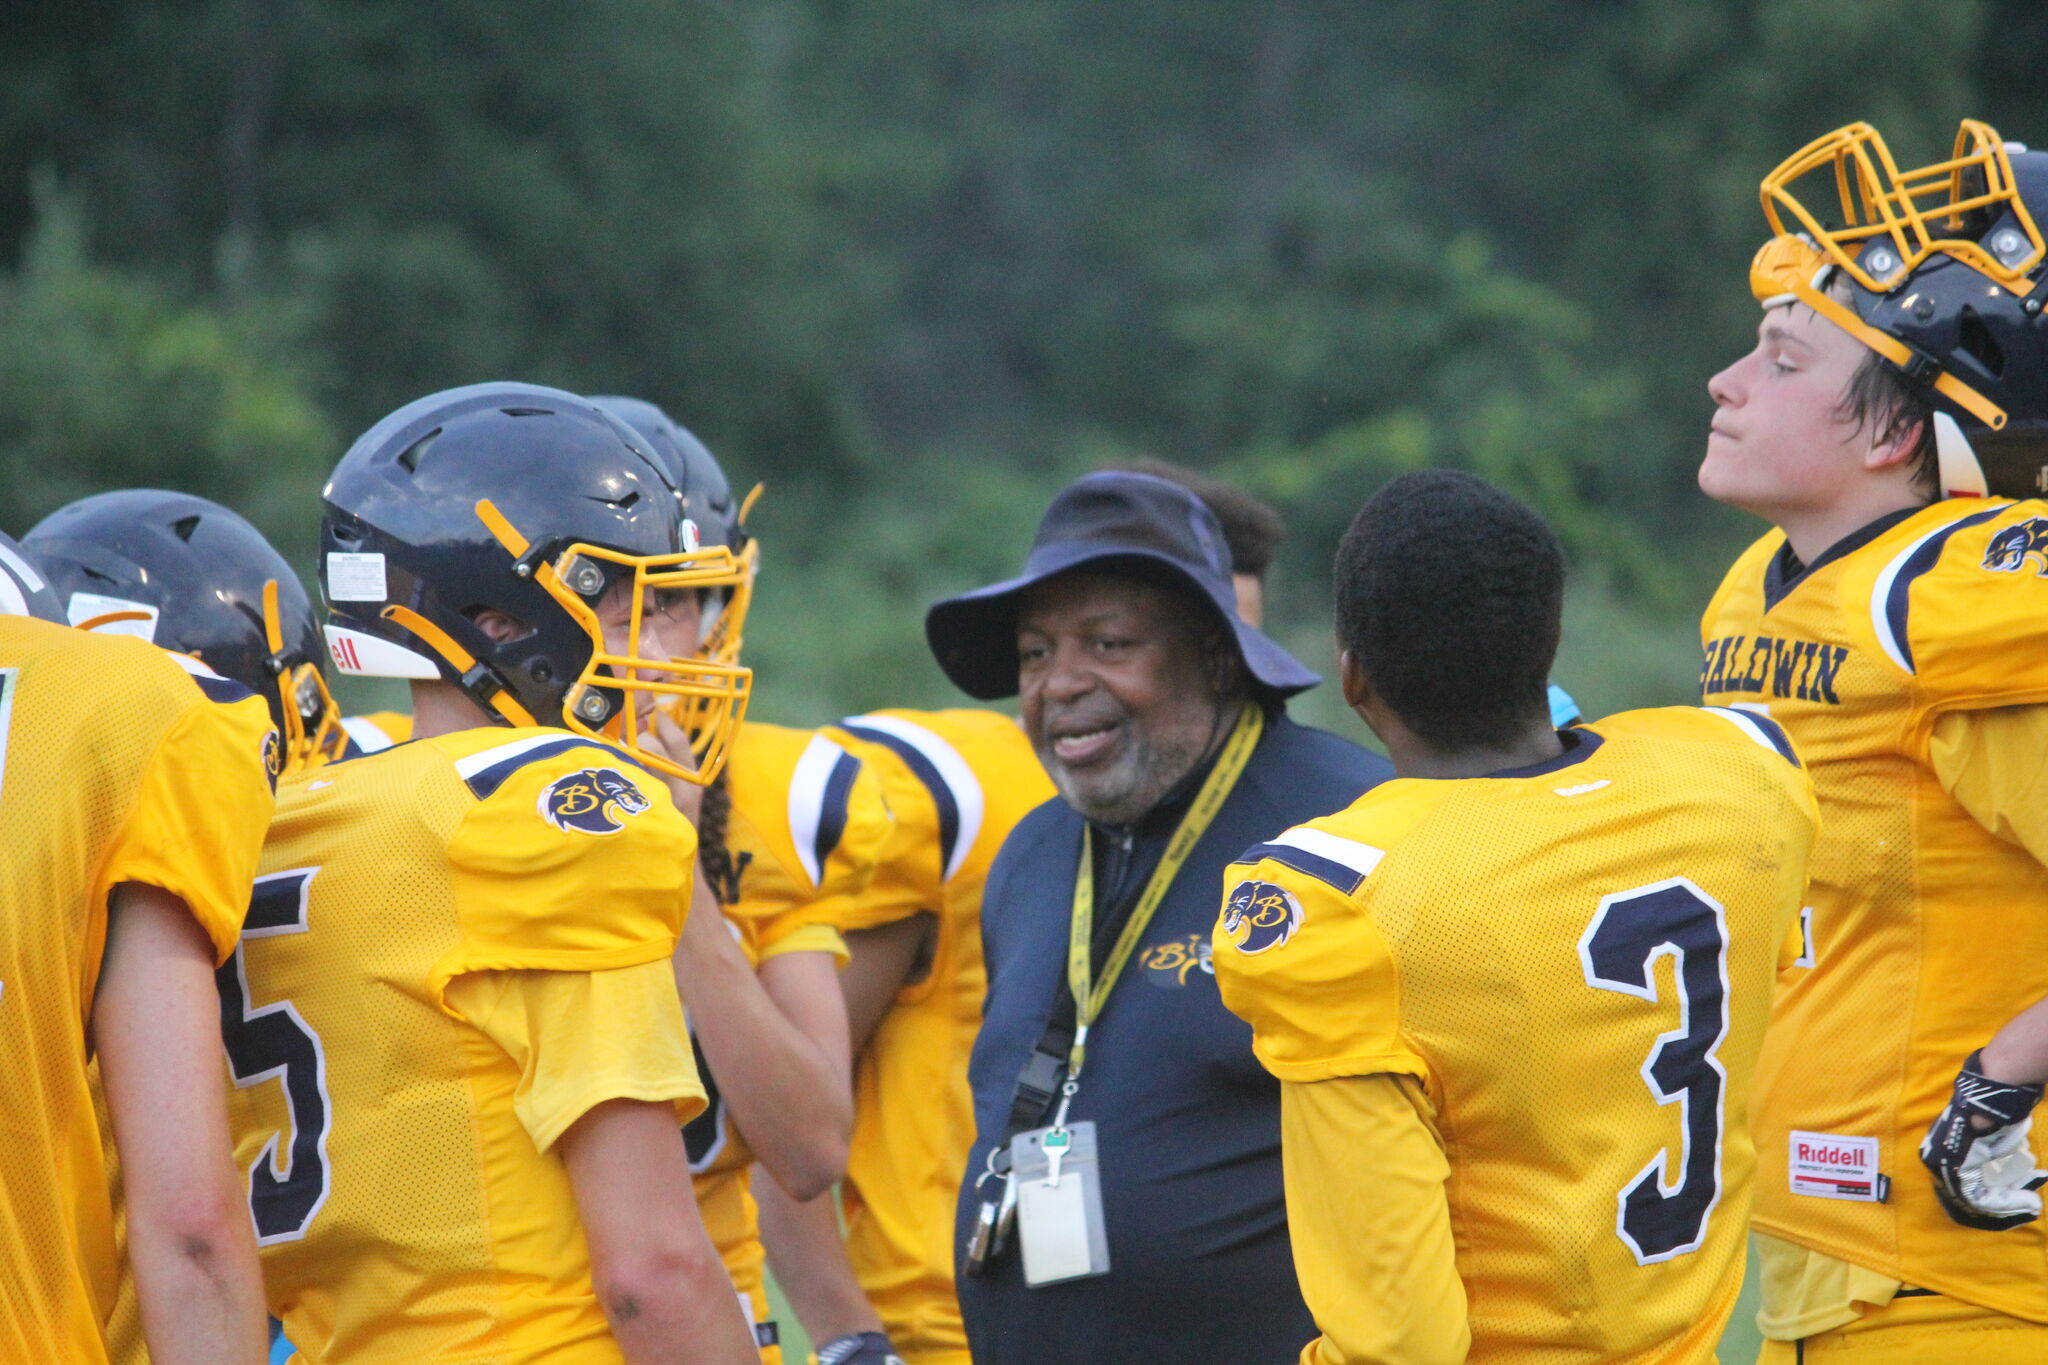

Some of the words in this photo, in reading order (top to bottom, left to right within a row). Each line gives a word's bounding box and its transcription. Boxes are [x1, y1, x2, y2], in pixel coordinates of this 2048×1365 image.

[553, 783, 600, 815] B
[1251, 893, 1288, 928] B
[213, 866, 330, 1247] 5
[1577, 876, 1730, 1266] 3
[1797, 1143, 1865, 1167] Riddell
